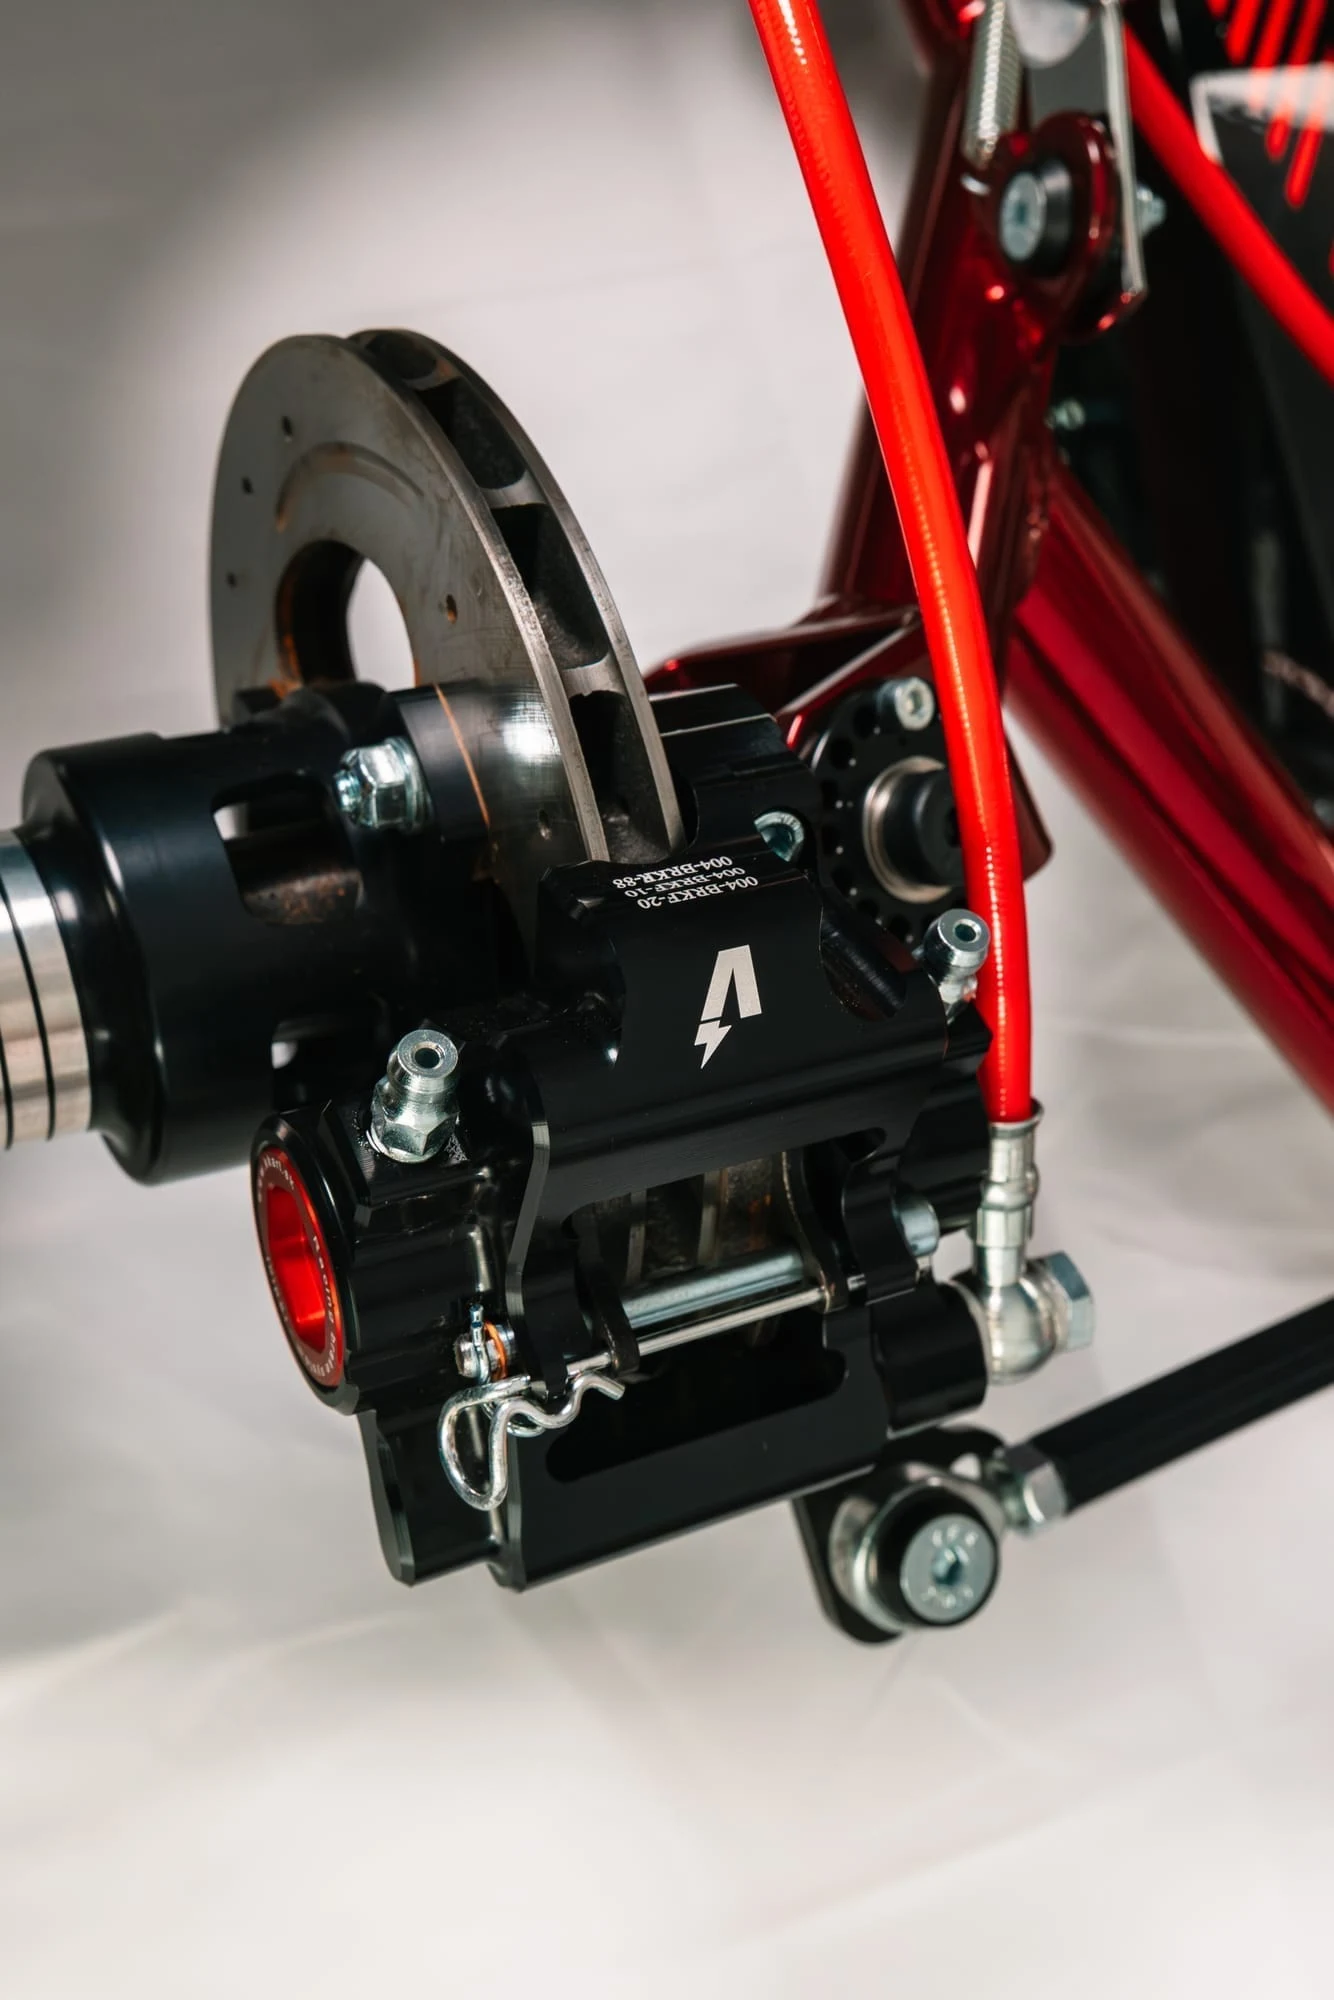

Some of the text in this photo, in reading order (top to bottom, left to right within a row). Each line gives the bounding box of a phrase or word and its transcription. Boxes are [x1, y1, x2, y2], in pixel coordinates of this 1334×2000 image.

[612, 855, 734, 889] 004-BRKR-88
[624, 867, 746, 898] 004-BRKF-10
[637, 876, 759, 910] 004-BRKF-20
